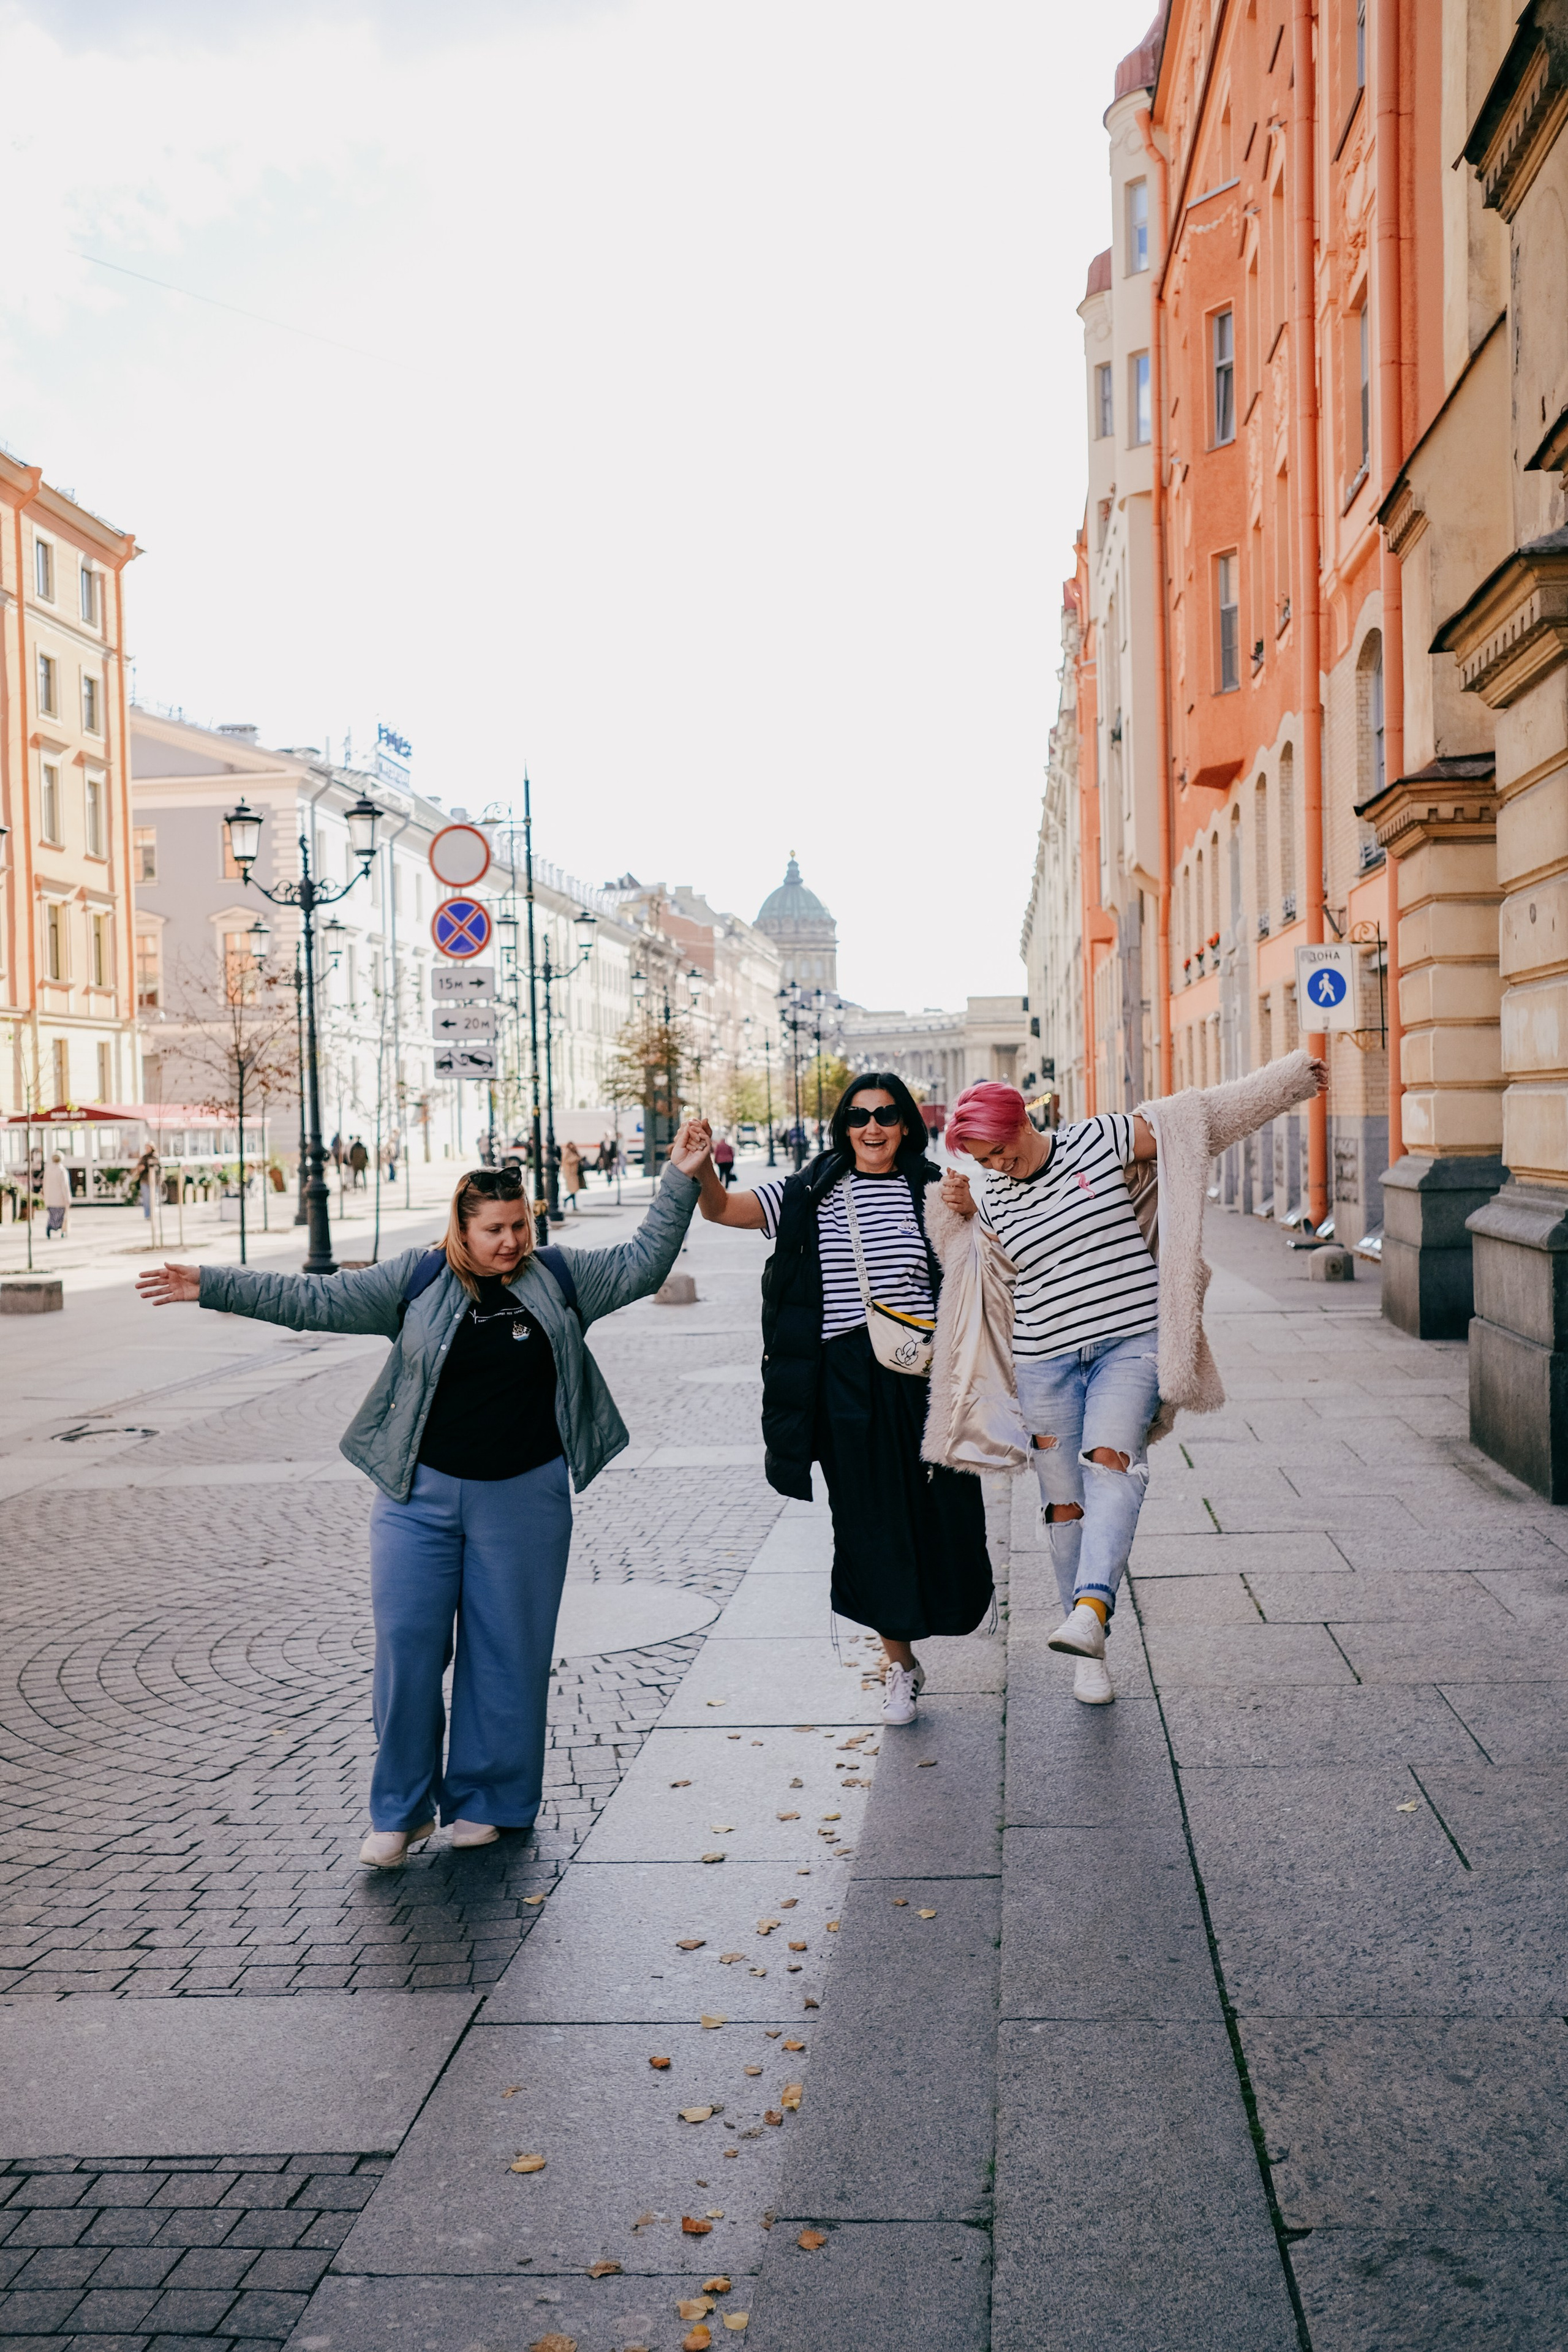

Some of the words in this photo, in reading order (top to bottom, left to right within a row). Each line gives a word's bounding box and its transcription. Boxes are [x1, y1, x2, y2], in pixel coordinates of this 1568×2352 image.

[1310, 951, 1340, 962] ЗОНА
[849, 1213, 858, 1227] LIFE!
[853, 1237, 862, 1253] THIS
[858, 1263, 866, 1280] LIFE!
